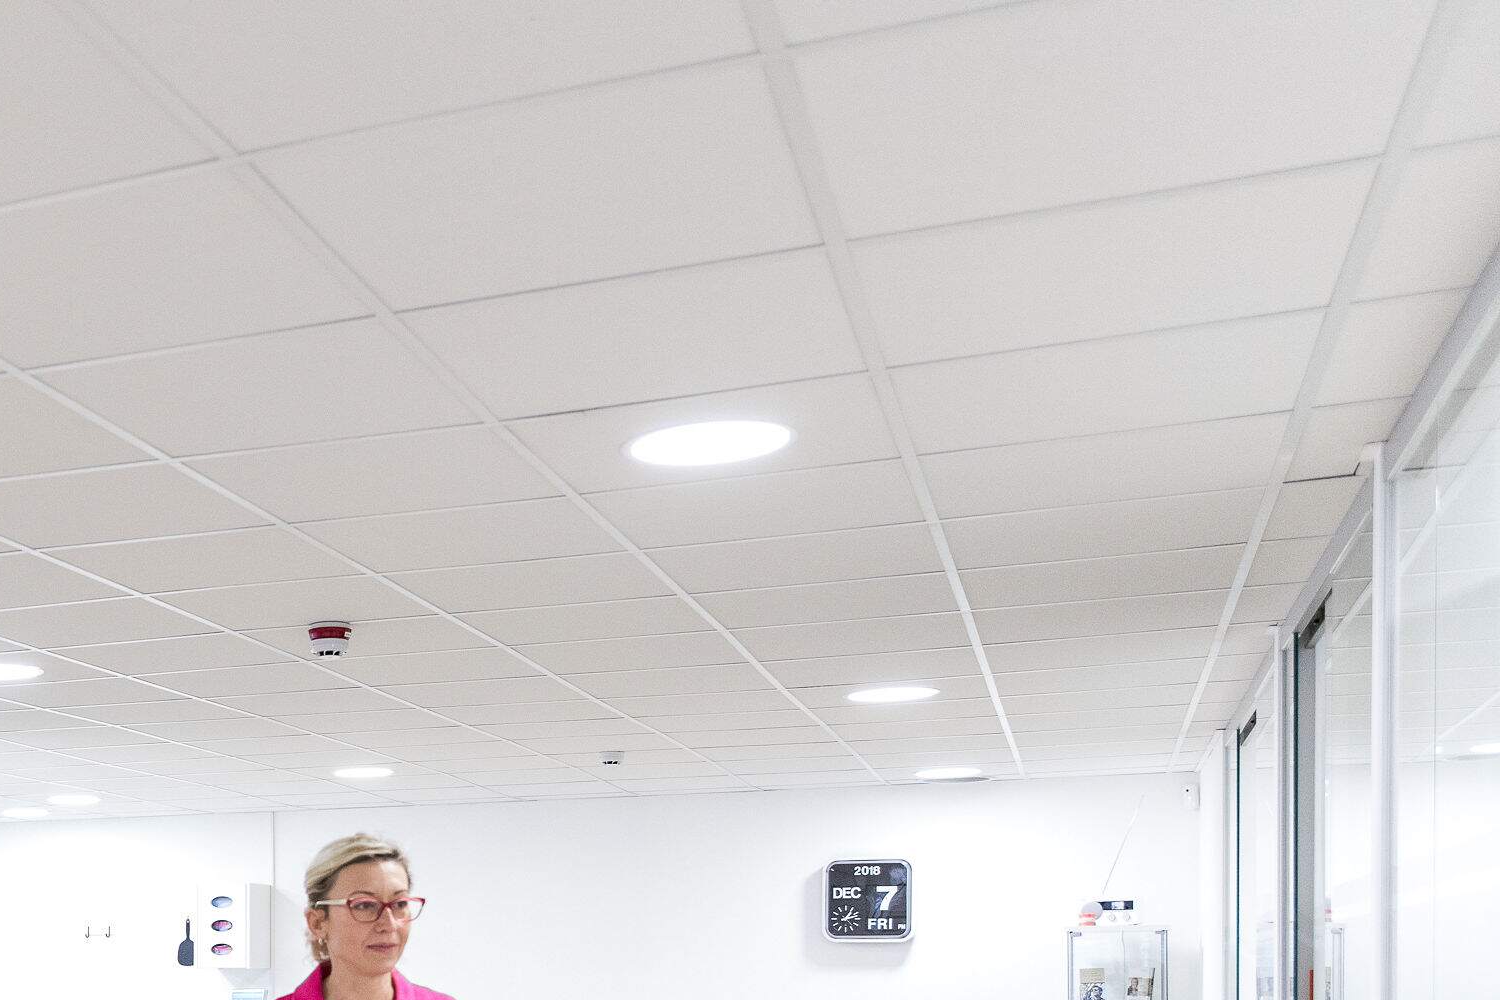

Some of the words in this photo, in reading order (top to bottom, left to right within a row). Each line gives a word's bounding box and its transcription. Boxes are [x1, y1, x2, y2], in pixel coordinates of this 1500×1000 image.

[854, 866, 881, 876] 2018
[832, 886, 862, 899] DEC
[876, 885, 898, 911] 7
[867, 918, 893, 930] FRI
